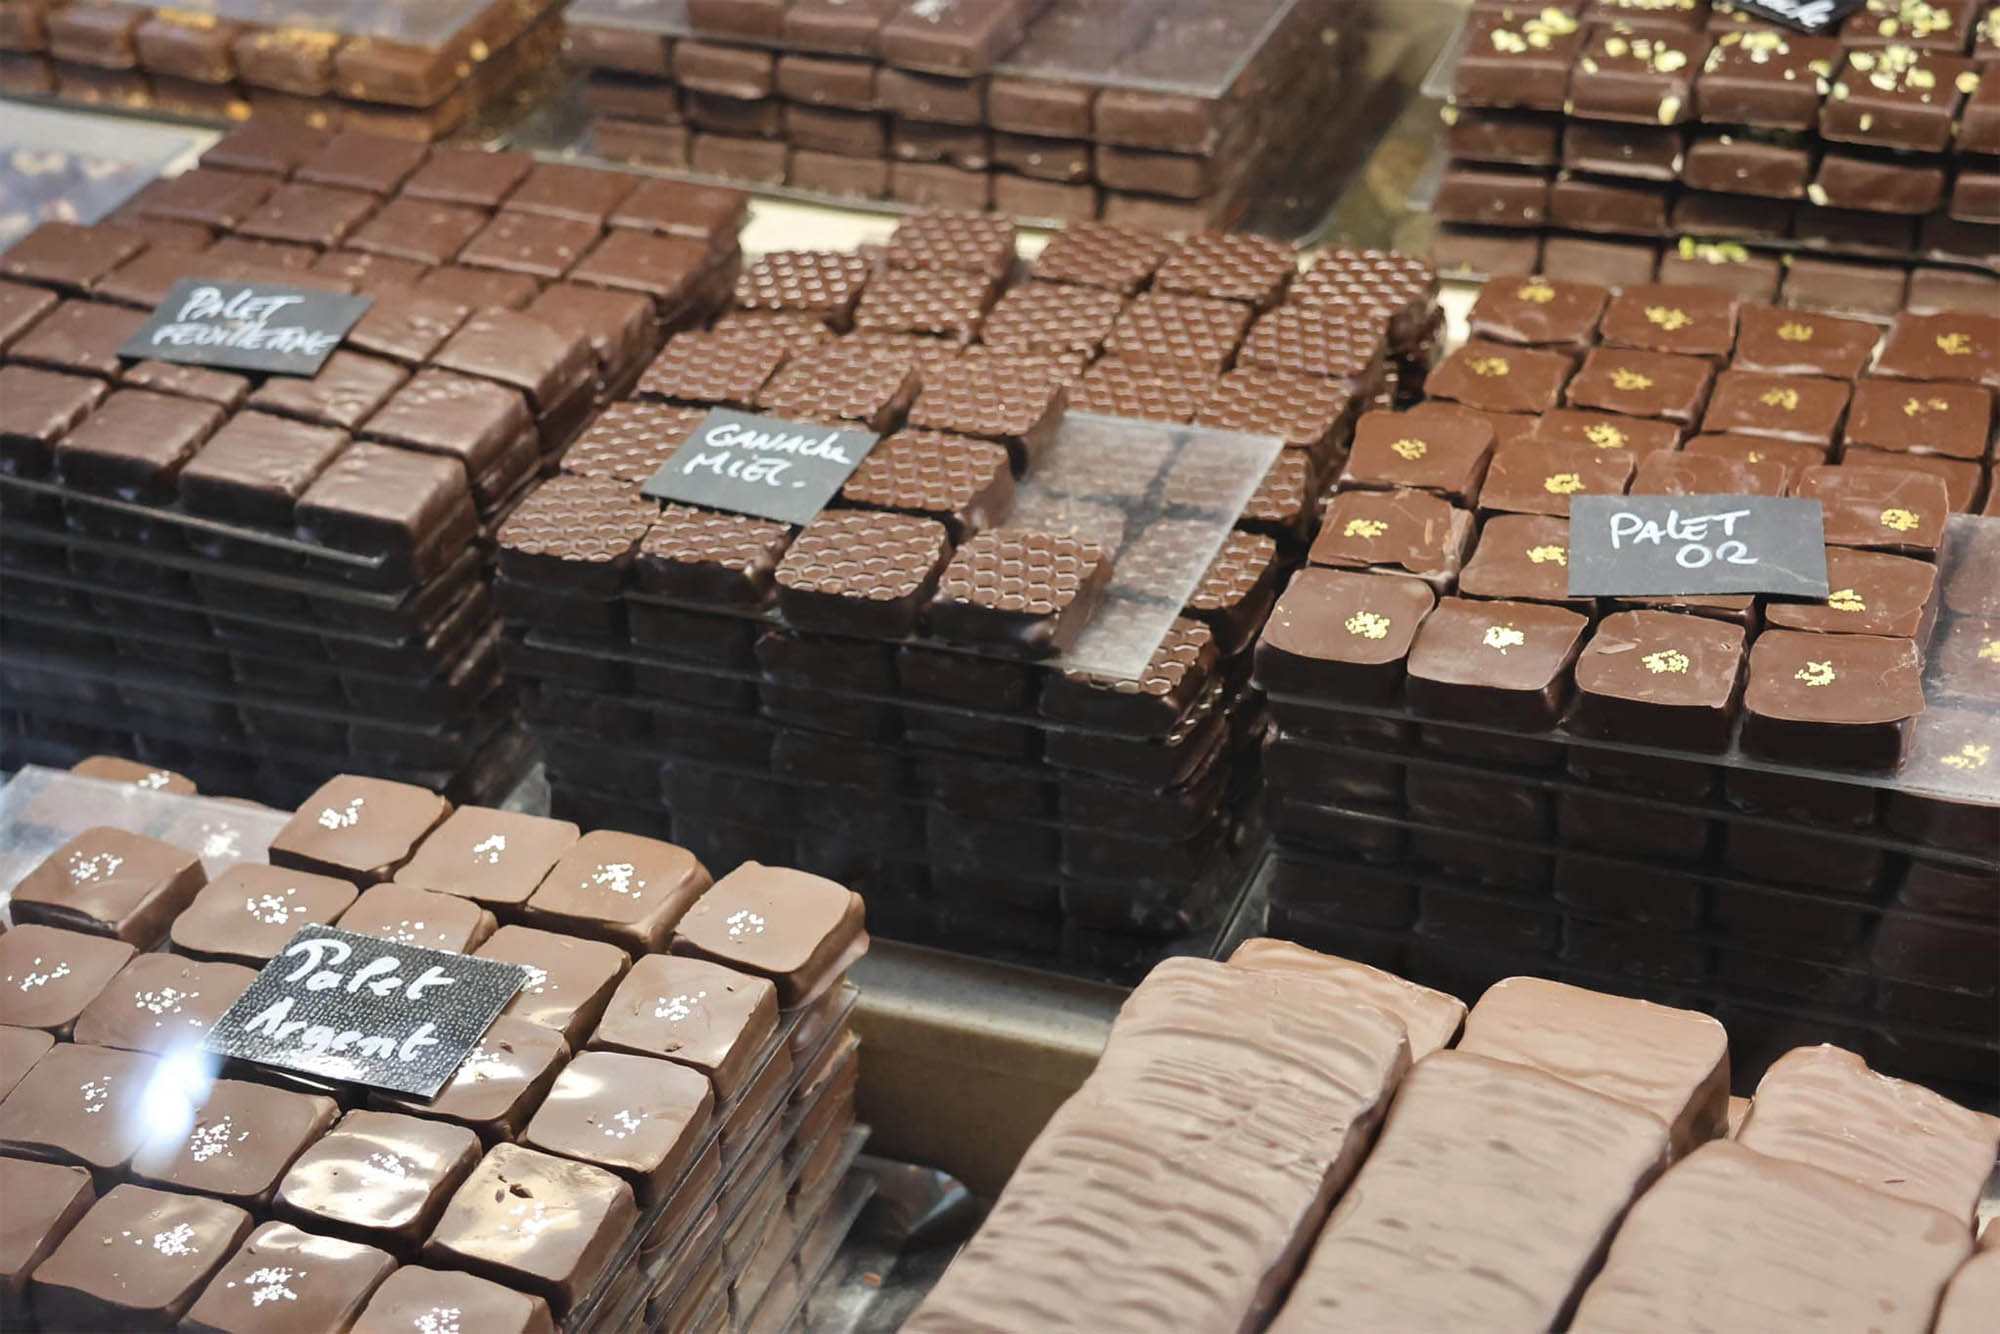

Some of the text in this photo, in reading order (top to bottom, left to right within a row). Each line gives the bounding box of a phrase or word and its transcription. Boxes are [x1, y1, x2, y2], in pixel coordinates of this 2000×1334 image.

[1610, 510, 1751, 549] PALET
[1675, 540, 1759, 569] OR
[285, 938, 456, 1001] Palet
[244, 997, 440, 1063] Argent
